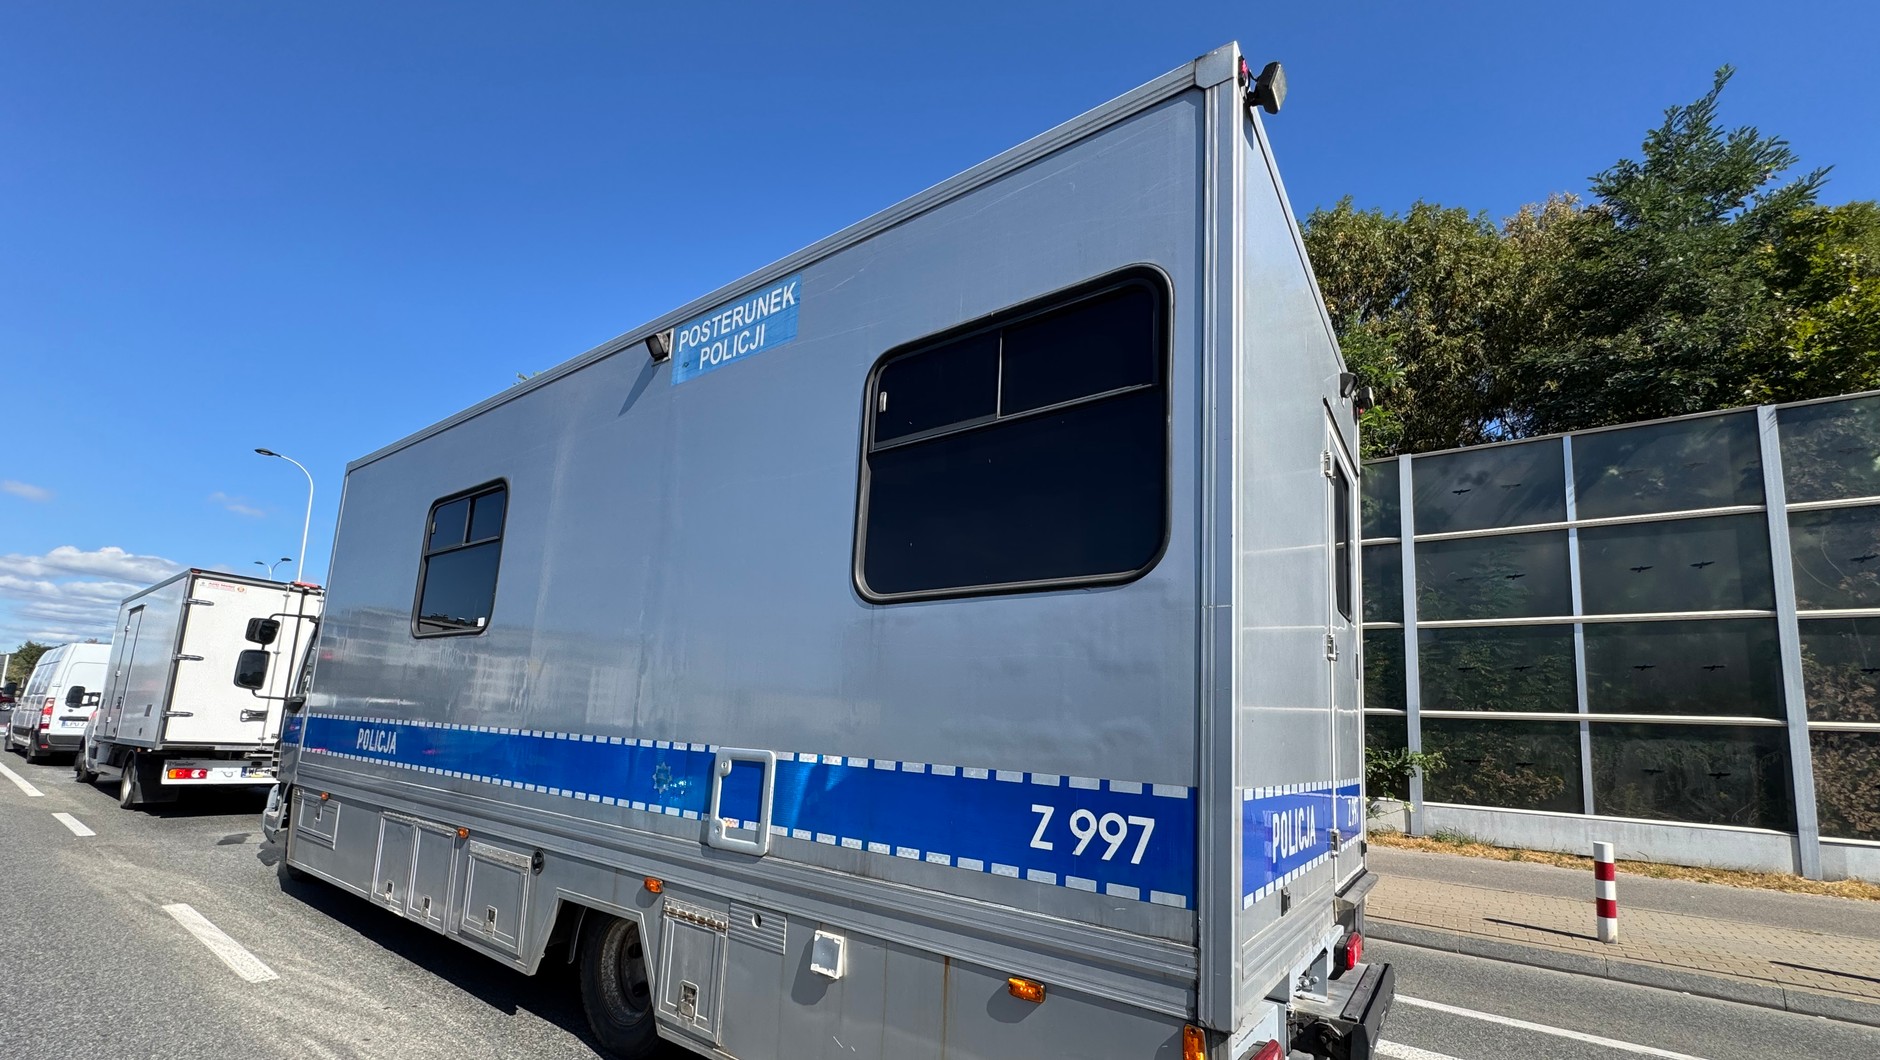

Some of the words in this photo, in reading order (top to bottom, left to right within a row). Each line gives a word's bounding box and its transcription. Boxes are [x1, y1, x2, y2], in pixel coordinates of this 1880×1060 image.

[678, 281, 797, 353] POSTERUNEK
[699, 323, 766, 370] POLICJI
[356, 727, 397, 755] POLICJA
[1030, 803, 1055, 851] Z
[1069, 808, 1156, 865] 997
[1272, 804, 1317, 864] POLICJA
